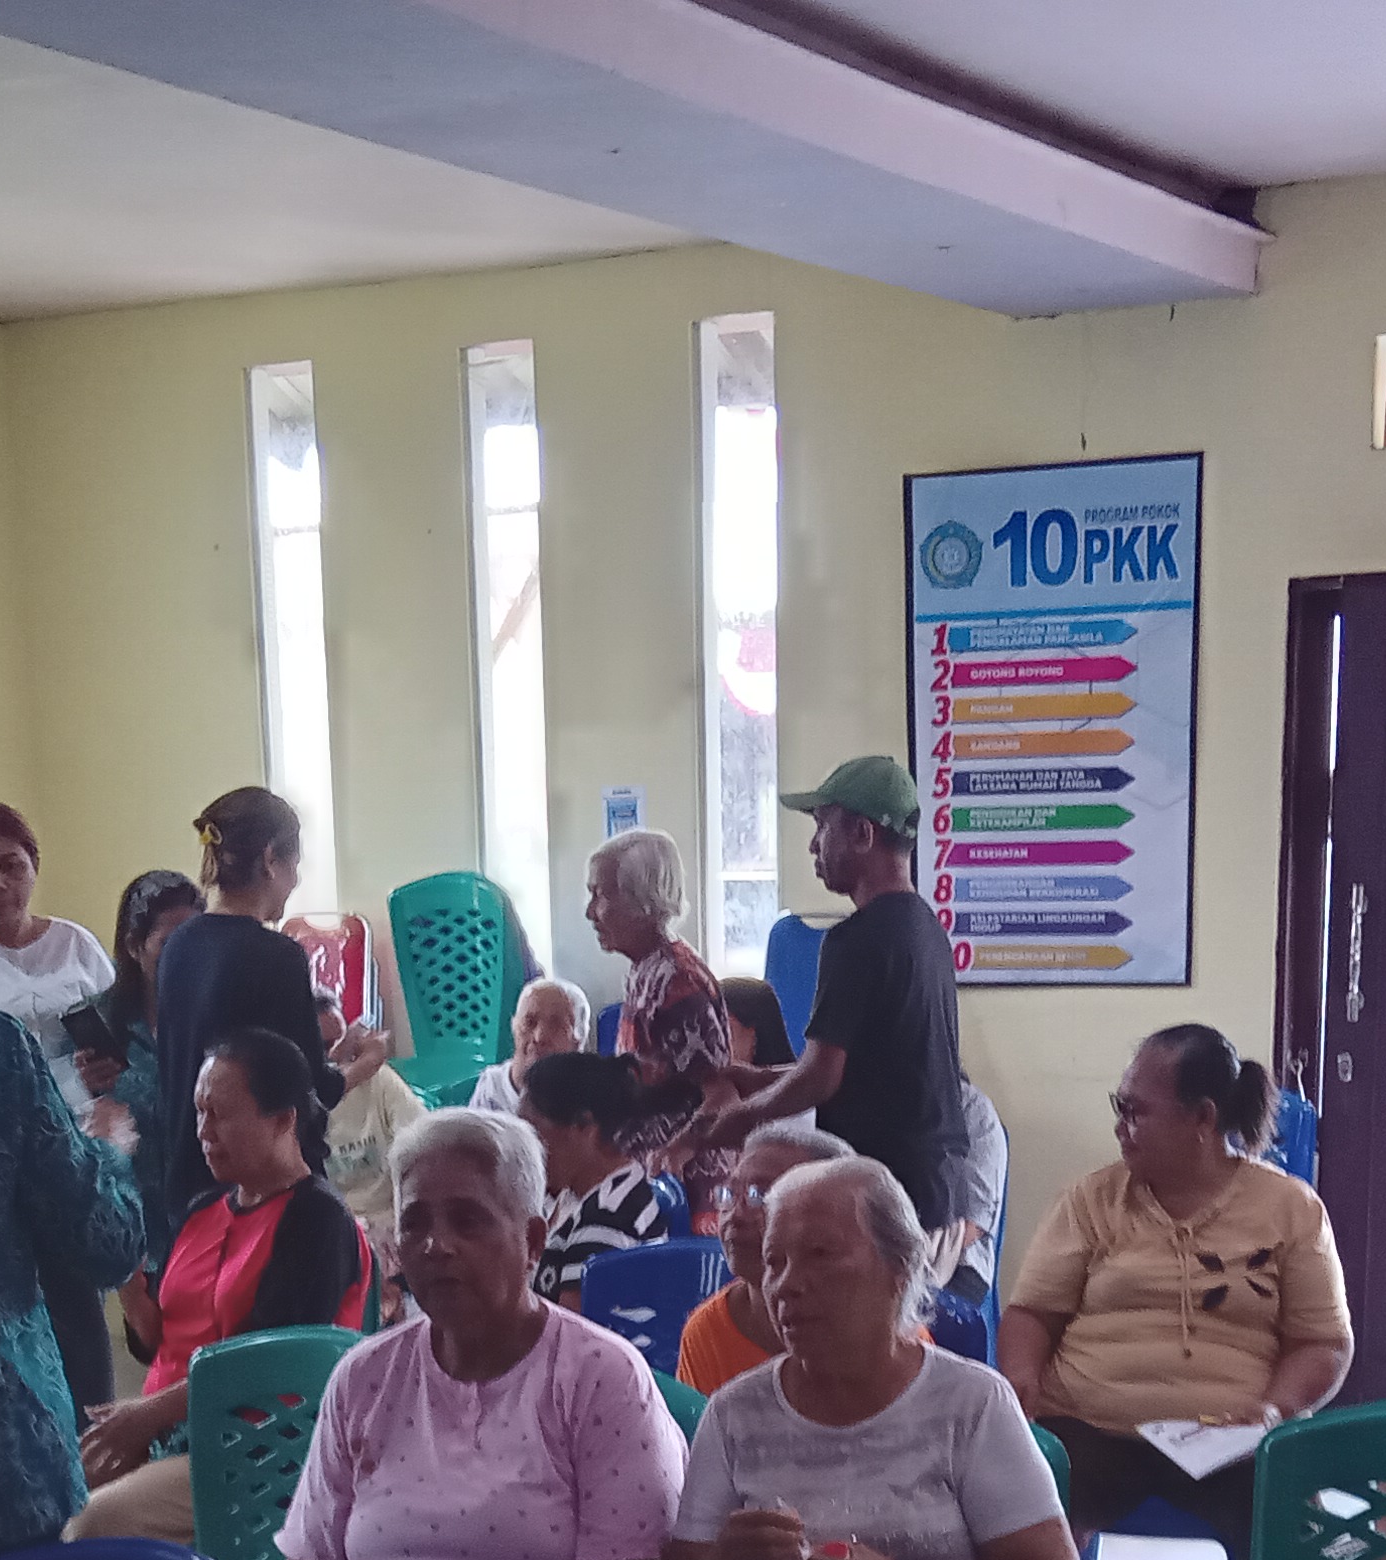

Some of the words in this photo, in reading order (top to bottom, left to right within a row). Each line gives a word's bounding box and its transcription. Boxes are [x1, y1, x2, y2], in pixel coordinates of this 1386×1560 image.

[1084, 504, 1139, 524] PROGRAM
[1141, 502, 1181, 520] POKOK
[992, 508, 1078, 588] 10
[1083, 523, 1179, 585] PKK
[930, 623, 948, 656] 1
[930, 659, 952, 693] 2
[931, 695, 952, 727] 3
[930, 731, 952, 763] 4
[931, 766, 952, 799] 5
[932, 803, 952, 835] 6
[933, 838, 953, 871] 7
[933, 873, 953, 905] 8
